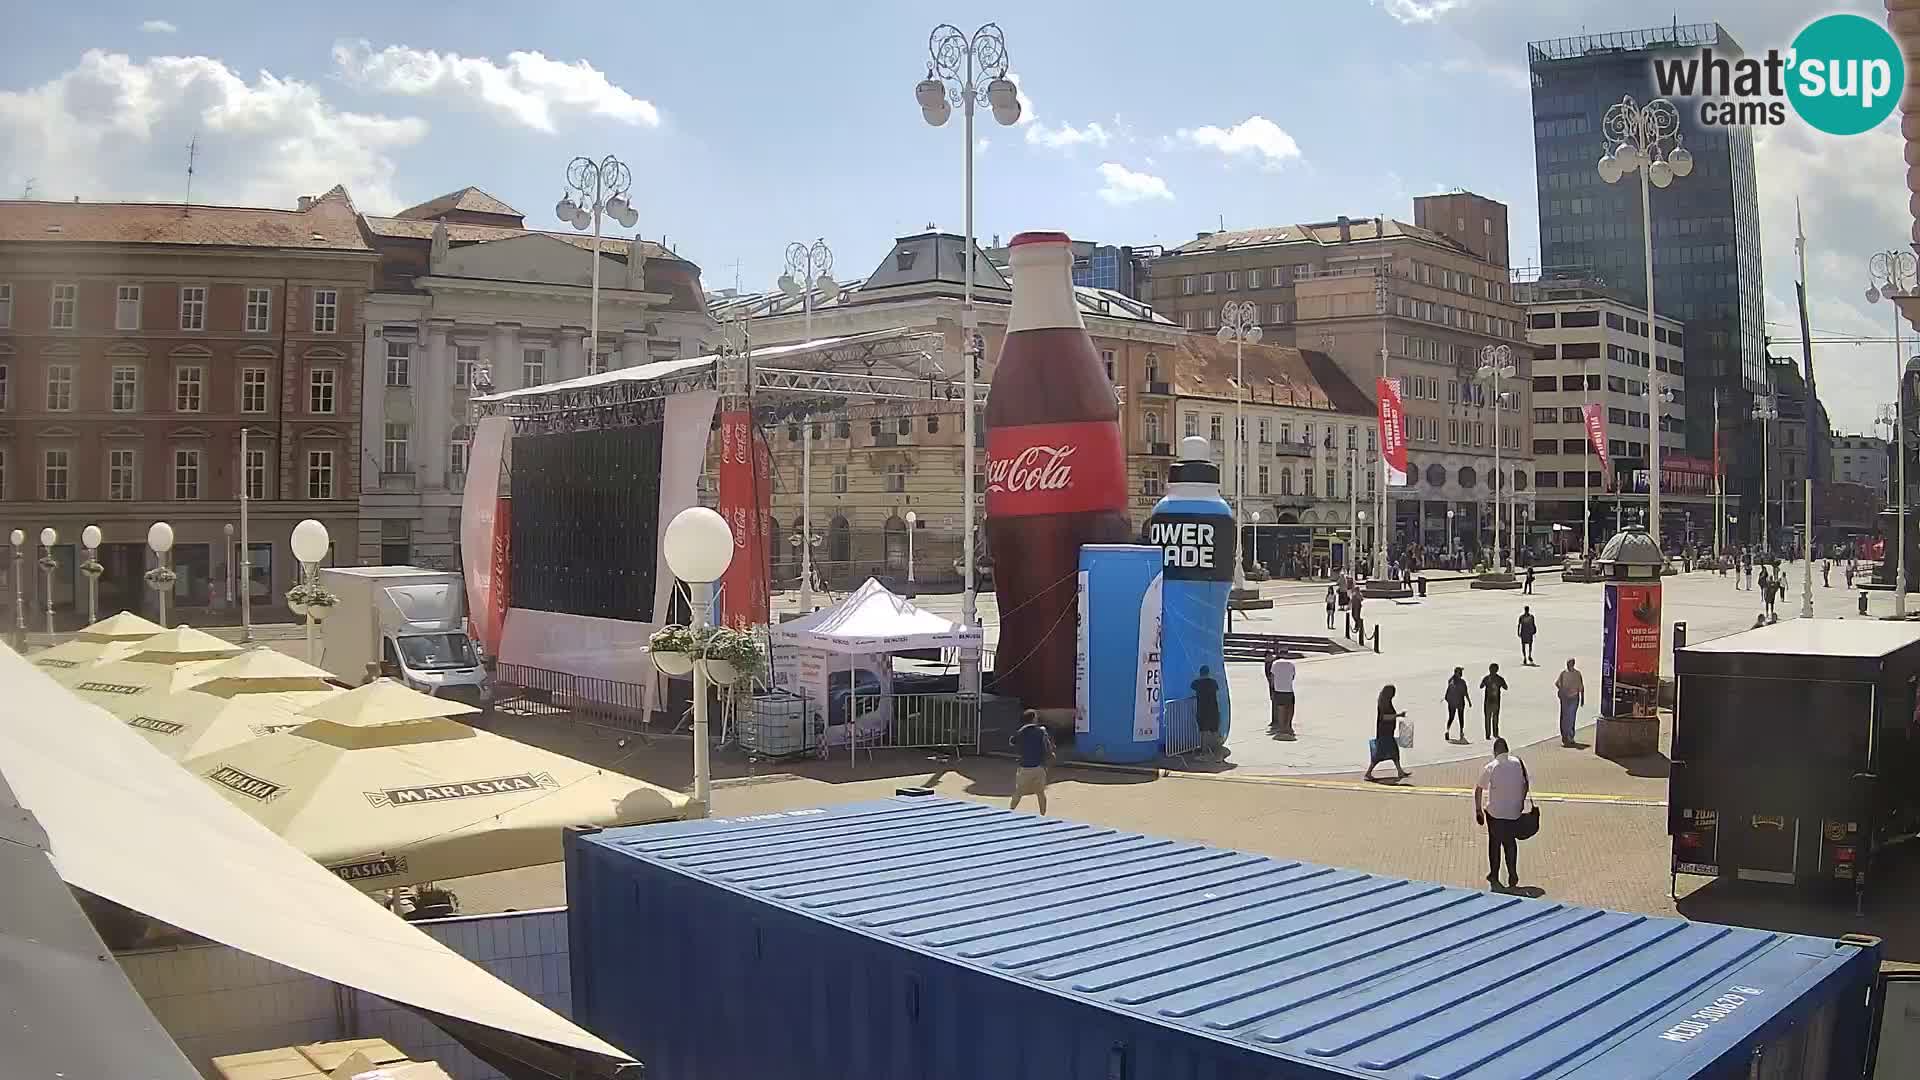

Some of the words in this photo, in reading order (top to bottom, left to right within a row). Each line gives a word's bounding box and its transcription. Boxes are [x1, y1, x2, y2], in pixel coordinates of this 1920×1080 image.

[1151, 523, 1214, 545] OWER
[1164, 545, 1214, 568] ADE
[212, 768, 275, 797] MARASKA
[398, 778, 531, 803] MARASKA
